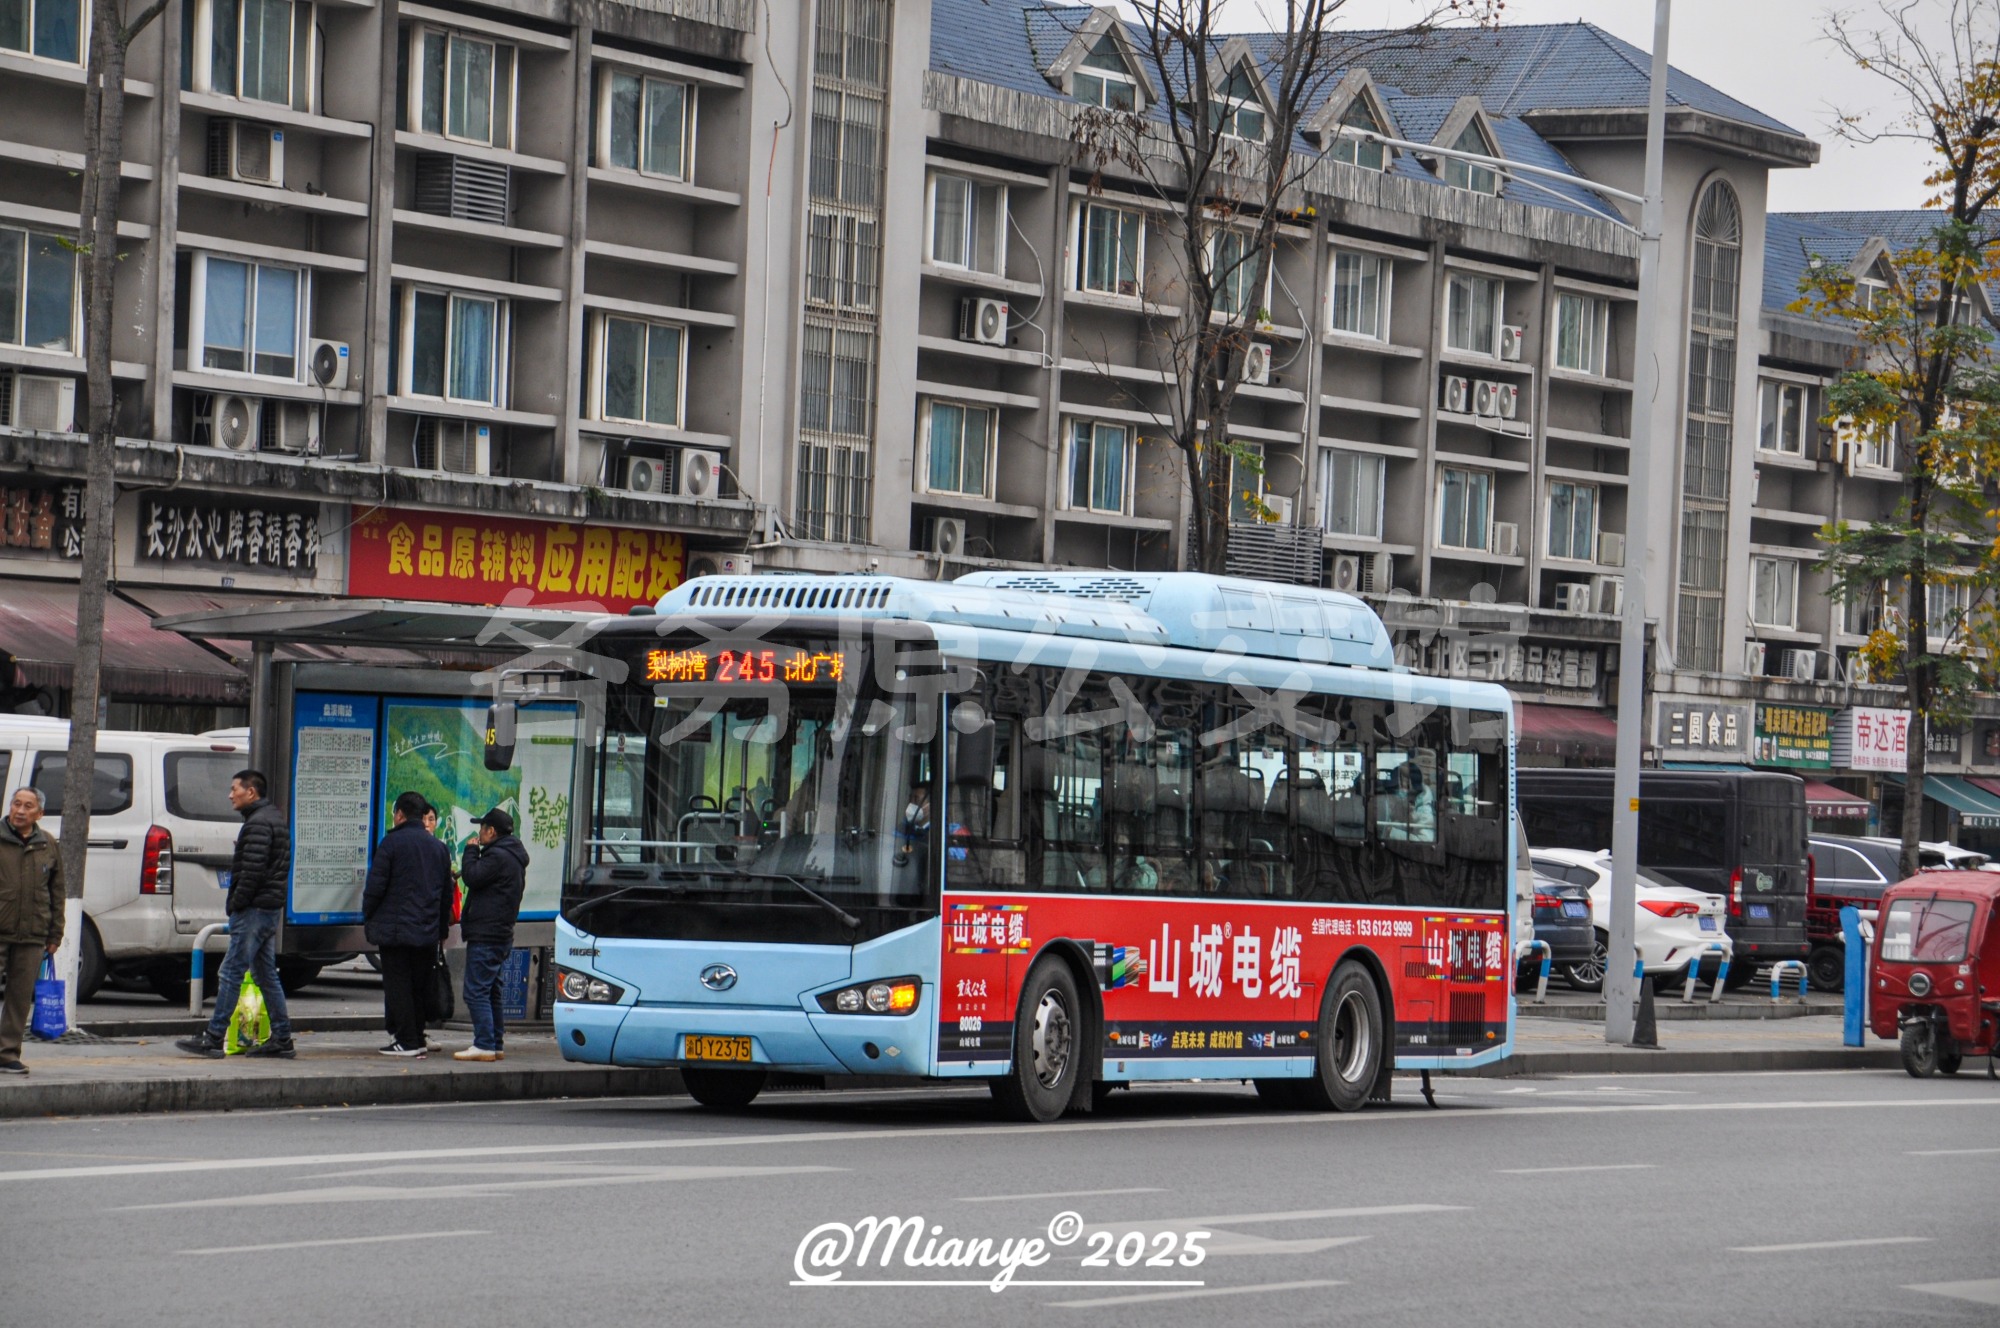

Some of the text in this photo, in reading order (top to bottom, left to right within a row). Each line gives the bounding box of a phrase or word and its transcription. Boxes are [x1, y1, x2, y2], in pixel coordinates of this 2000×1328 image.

[62, 485, 87, 519] 有
[62, 525, 86, 558] 公
[387, 521, 683, 601] 食品原辅料应用配送
[647, 650, 708, 680] 梨树湾
[718, 651, 775, 682] 245
[1671, 711, 1737, 746] 三圆食品
[1857, 711, 1906, 753] 帝达酒
[1356, 919, 1371, 936] 153
[1373, 919, 1391, 937] 6123
[1393, 920, 1413, 937] 9999
[960, 1016, 981, 1031] 80026
[1171, 1030, 1243, 1049] 点亮未来 成就价值
